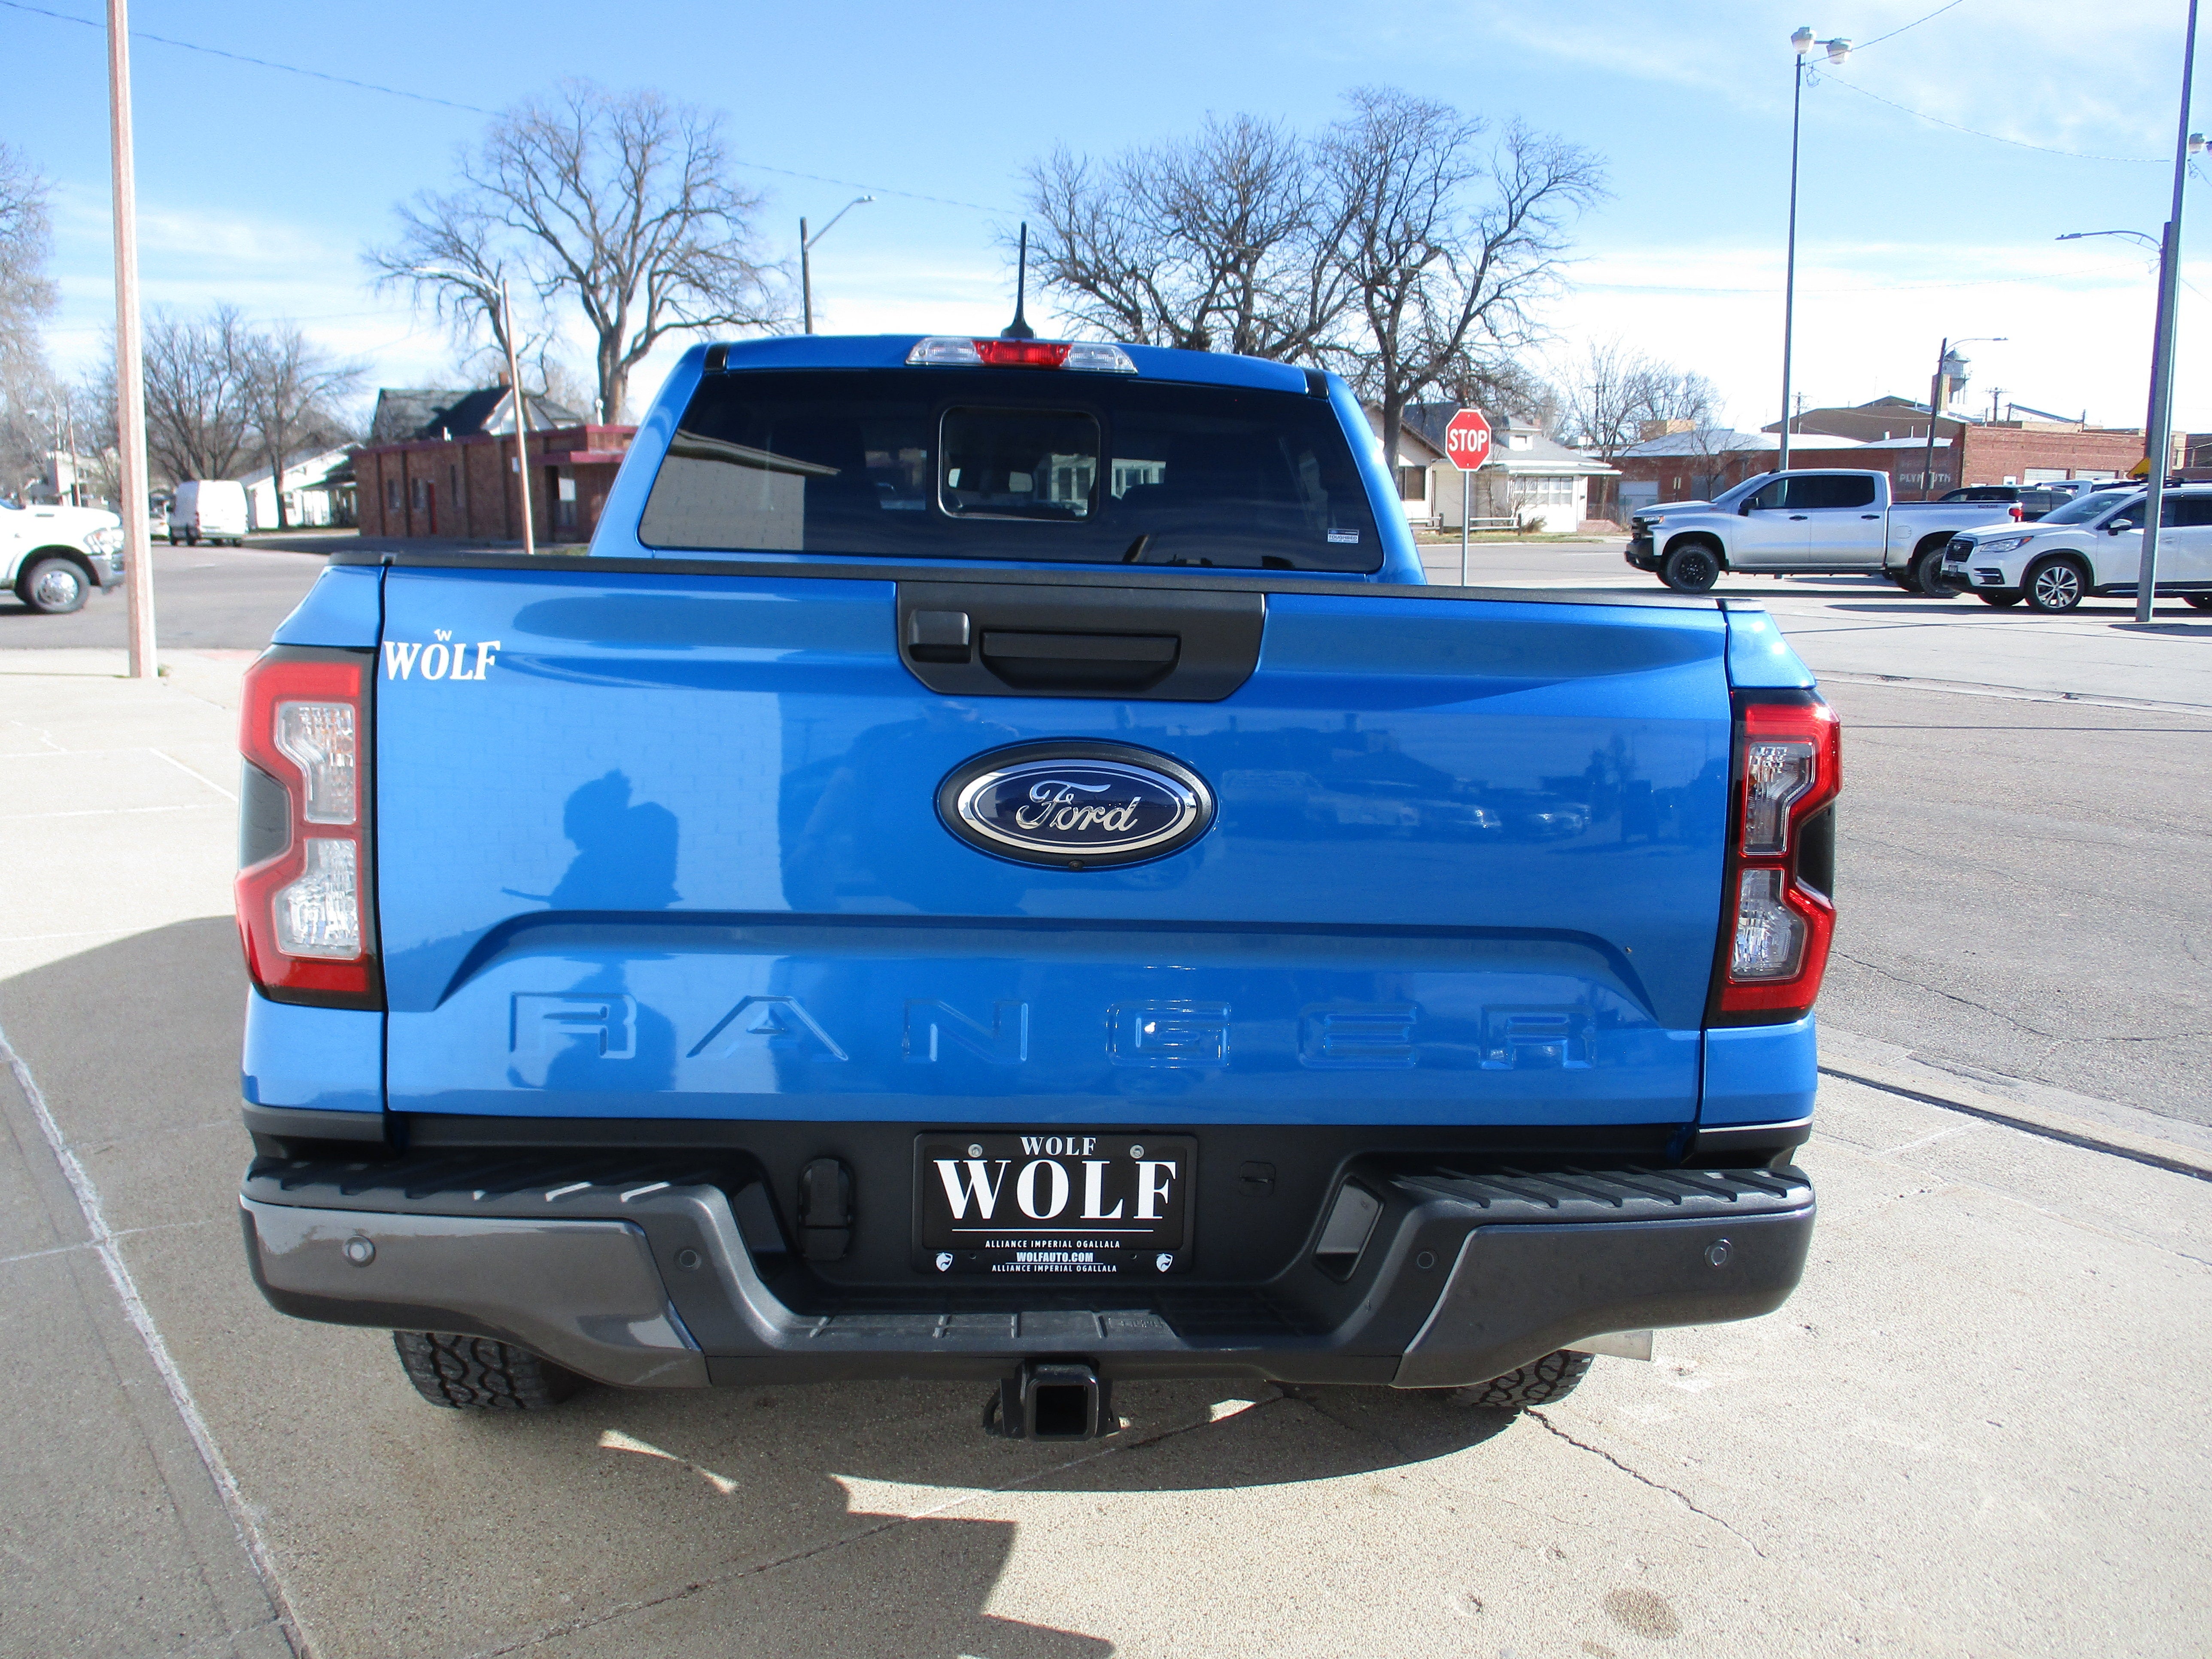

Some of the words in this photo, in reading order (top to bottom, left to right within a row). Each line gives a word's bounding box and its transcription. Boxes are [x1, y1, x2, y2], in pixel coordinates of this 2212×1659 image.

[1449, 428, 1488, 452] STOP
[383, 641, 501, 680] WOLF
[1015, 780, 1142, 831] Ford
[510, 991, 1596, 1070] RANGER
[1020, 1136, 1097, 1156] WOLF
[933, 1159, 1176, 1220] WOLF
[985, 1240, 1027, 1248] ALLIANCE
[1031, 1240, 1073, 1248] IMPERIAL
[1076, 1240, 1120, 1248] OGALLALA
[1016, 1252, 1094, 1262] WOLFAUTO.COM
